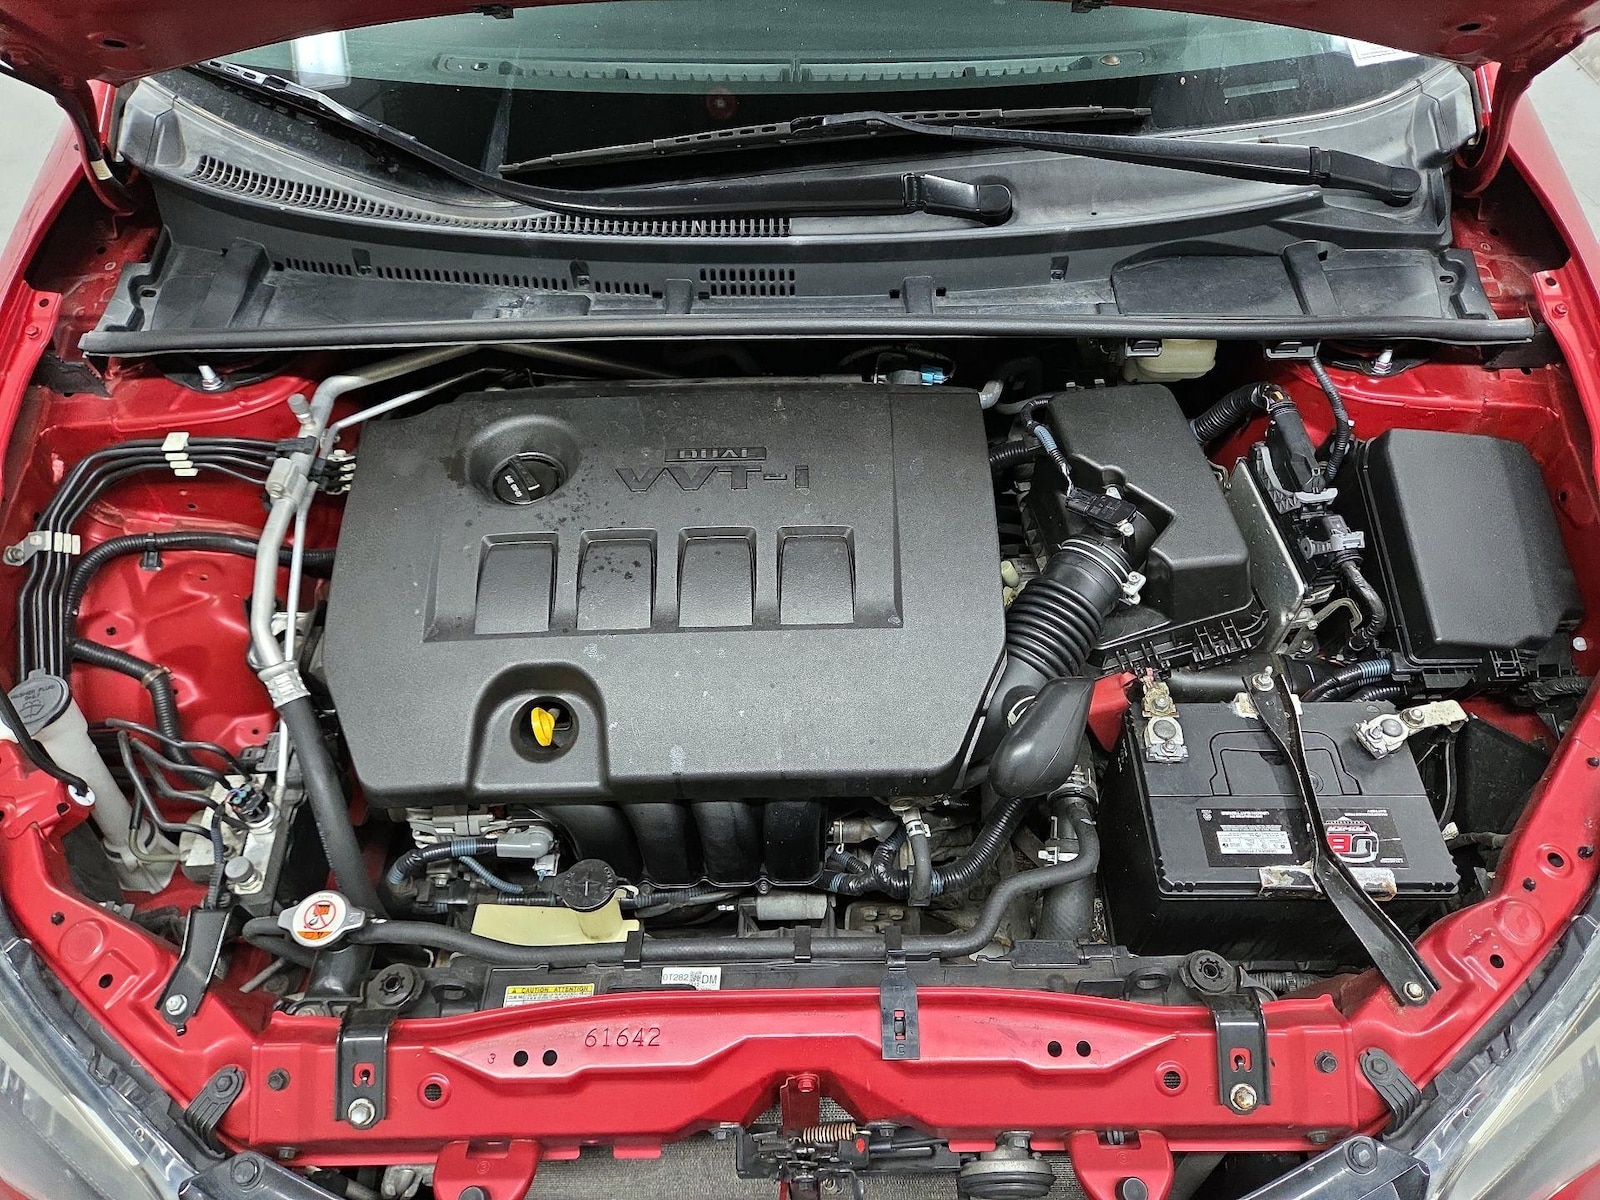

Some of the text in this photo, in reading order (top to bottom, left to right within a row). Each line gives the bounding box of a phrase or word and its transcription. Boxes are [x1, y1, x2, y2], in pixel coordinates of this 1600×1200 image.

[701, 974, 718, 984] DM
[521, 984, 589, 994] CAUTION ATTENTION
[585, 1027, 661, 1048] 61642
[487, 1053, 496, 1064] 3
